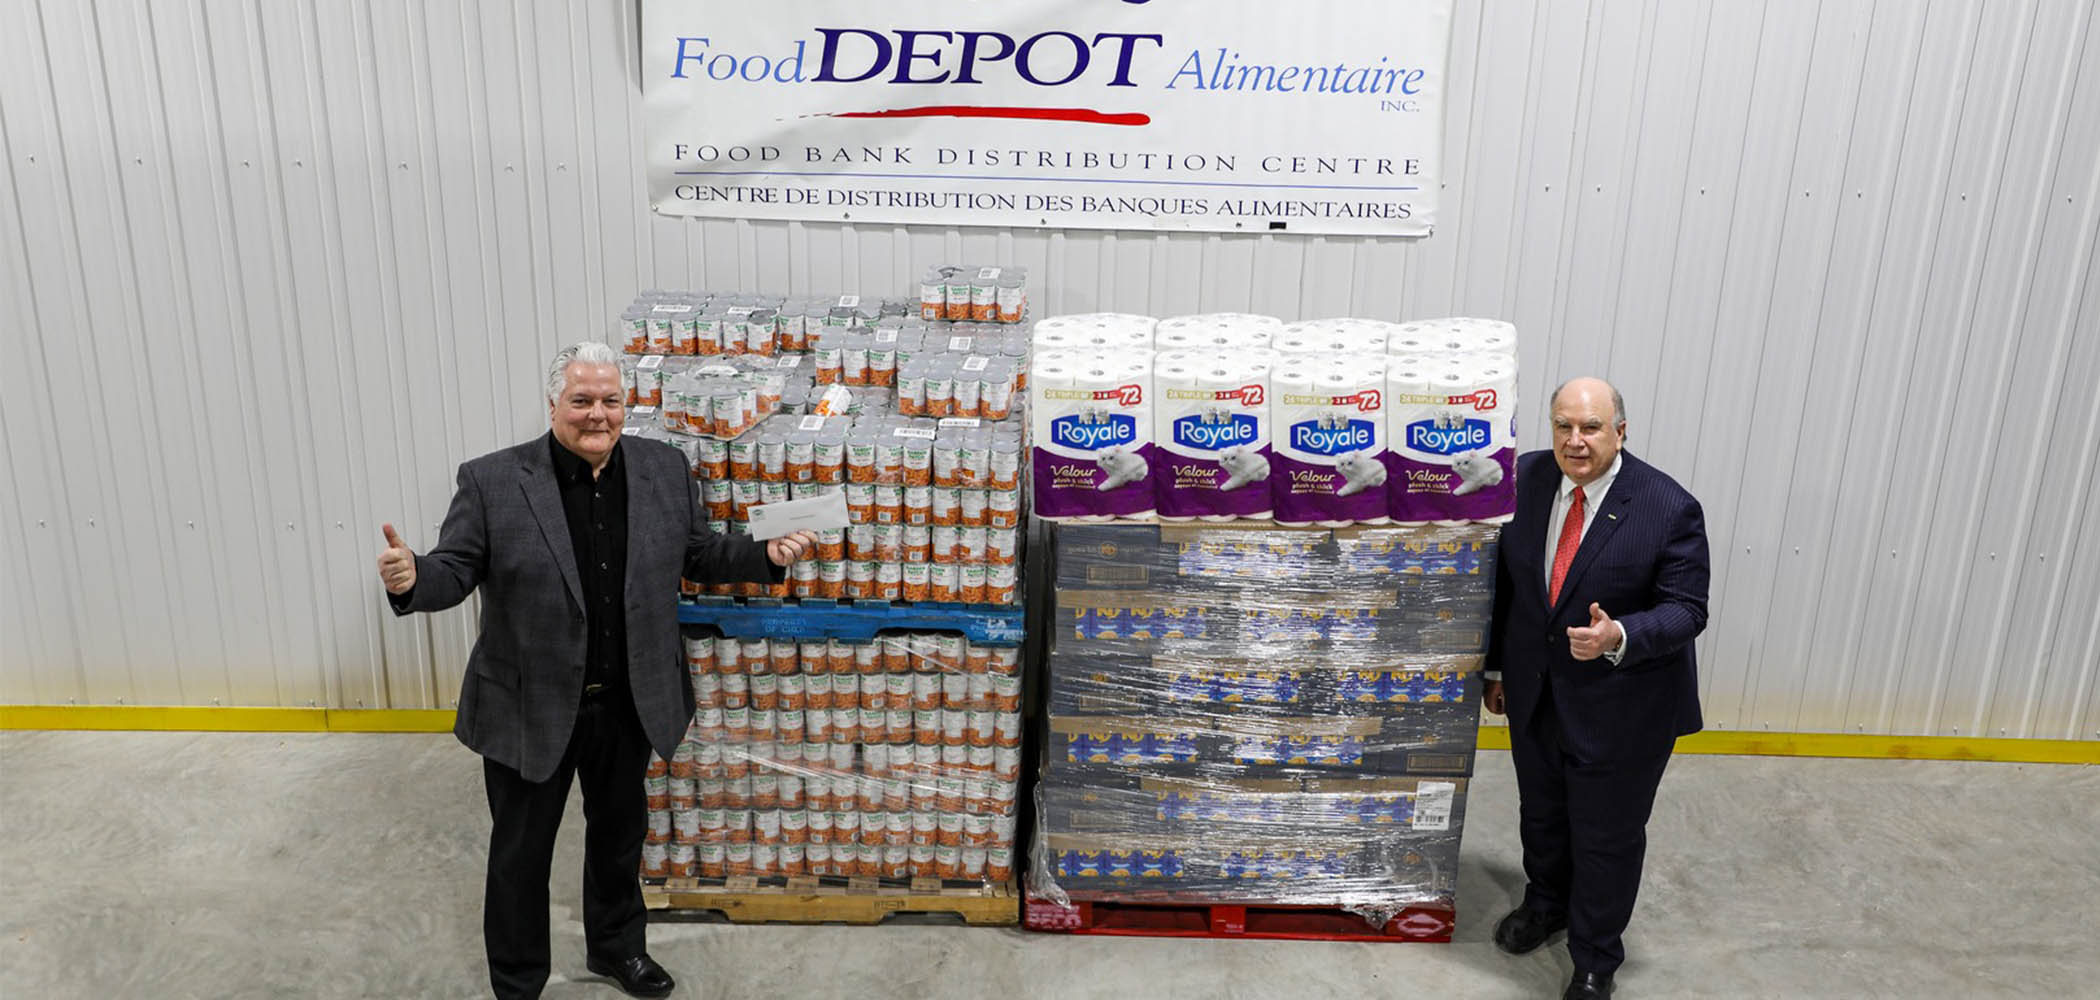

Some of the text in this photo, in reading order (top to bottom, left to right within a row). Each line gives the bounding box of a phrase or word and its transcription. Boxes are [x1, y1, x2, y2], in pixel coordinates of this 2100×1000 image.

[670, 28, 1424, 95] Food DEPOT Alimentaire
[1380, 100, 1420, 112] INC.
[674, 144, 1420, 175] FOOD BANK DISTRIBUTION CENTRE
[674, 185, 1411, 219] CENTRE DE DISTRIBUTION DES BANQUES ALIMENTAIRES
[1120, 387, 1139, 404] 72
[1242, 387, 1261, 404] 72
[1359, 392, 1378, 409] 72
[1475, 392, 1494, 409] 72
[1058, 420, 1130, 448] Royale
[1180, 420, 1252, 448] Royale
[1297, 426, 1368, 453] Royale
[1413, 425, 1484, 452] Royale
[1050, 464, 1096, 476] Velour
[1172, 464, 1219, 476] Velour
[1289, 470, 1335, 482] Velour
[1405, 469, 1452, 481] Velour
